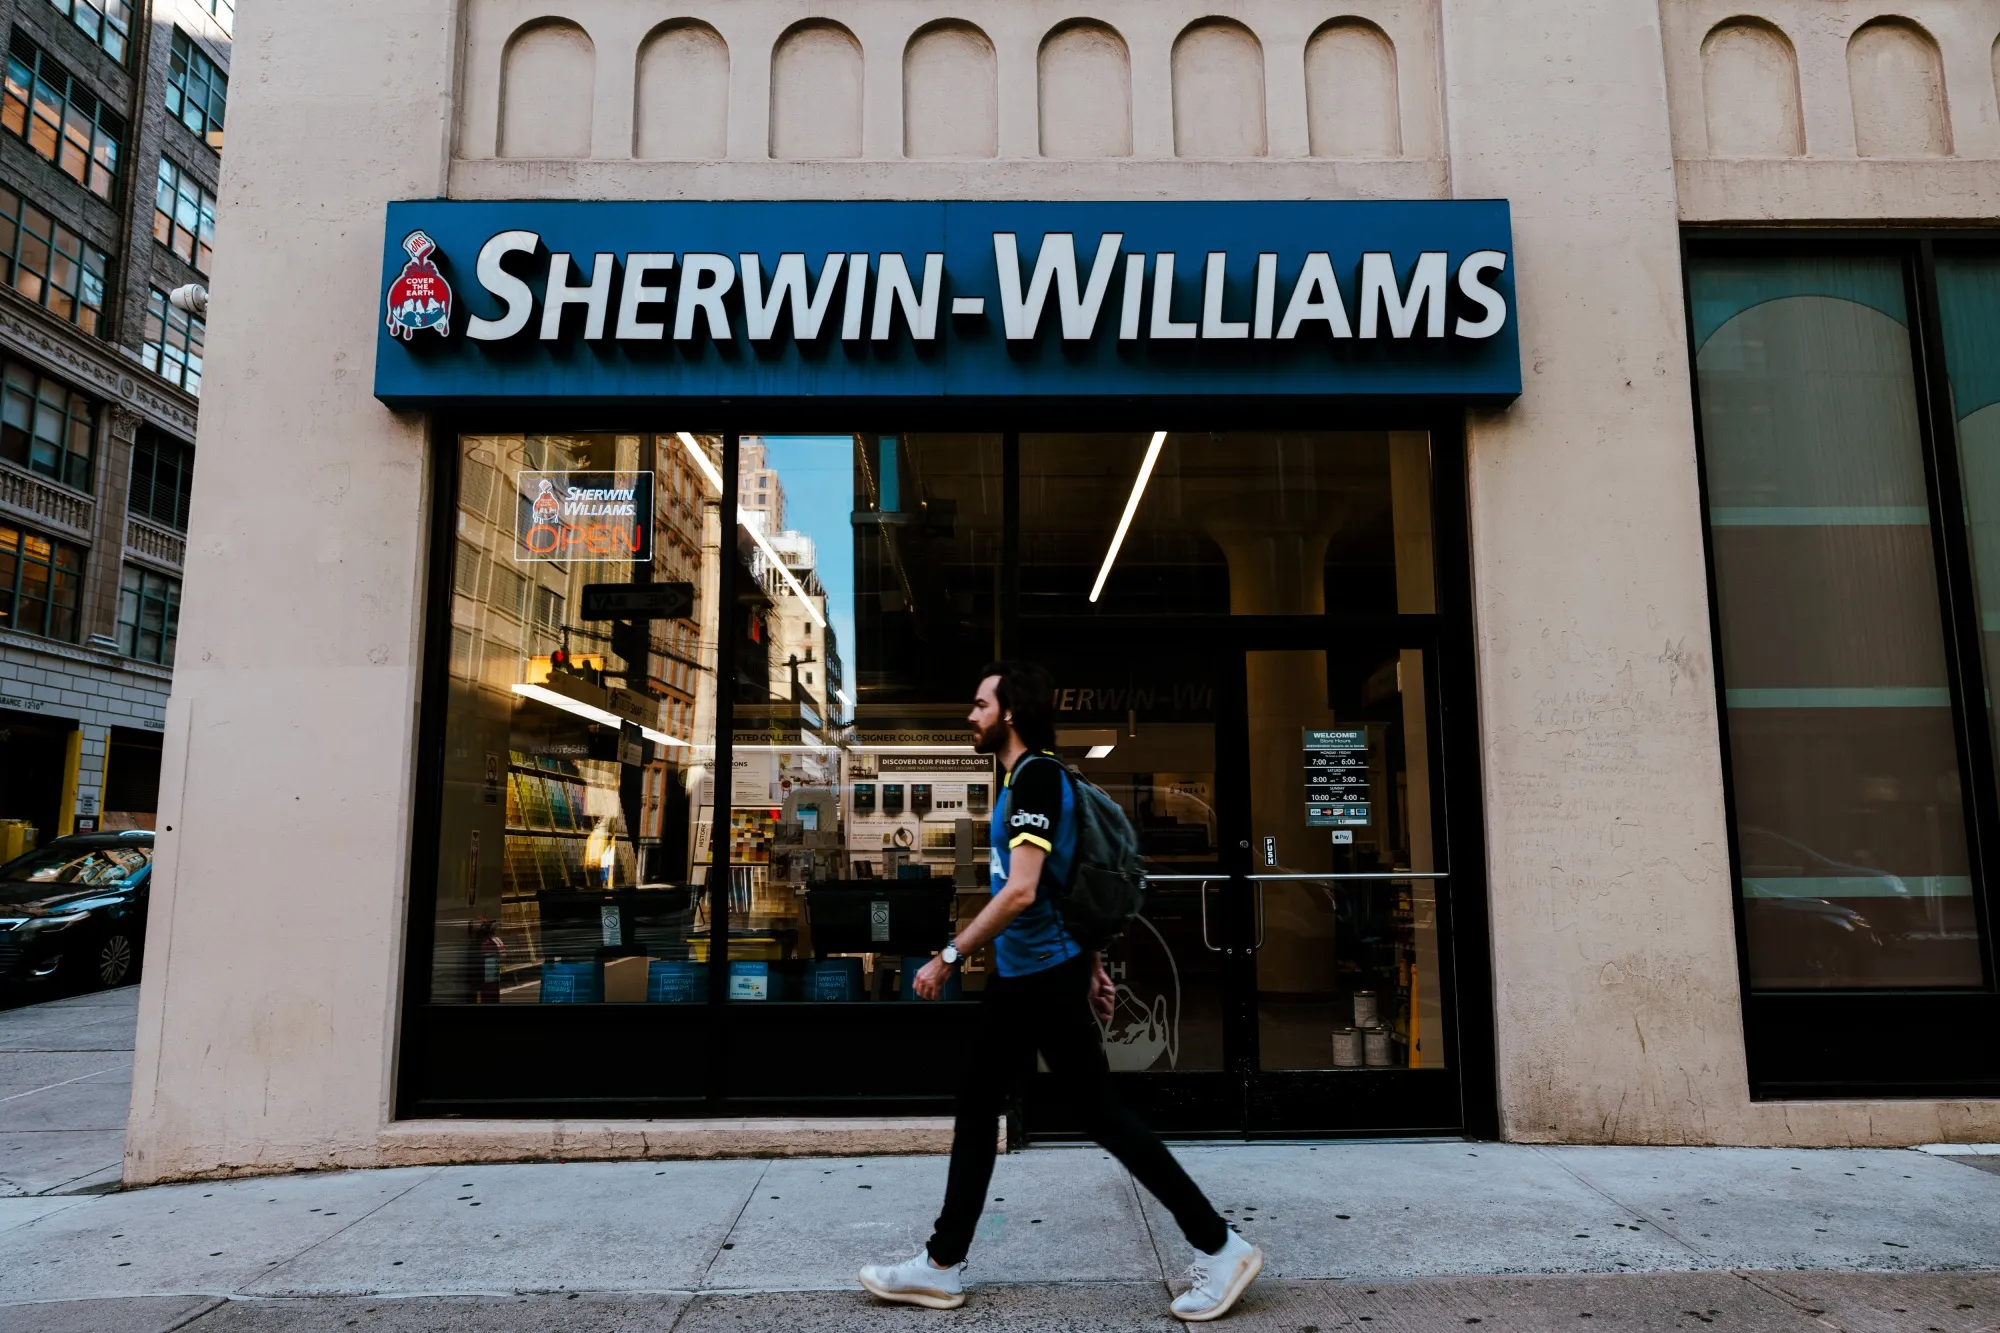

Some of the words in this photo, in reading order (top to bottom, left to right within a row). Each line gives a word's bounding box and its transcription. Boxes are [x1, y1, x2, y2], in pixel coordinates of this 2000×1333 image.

[410, 236, 427, 253] SWP
[466, 229, 1508, 341] SHERWIN-WILLIAMS
[406, 289, 434, 297] EARTH
[565, 486, 635, 501] SHERWIN
[564, 502, 635, 516] WILLIAMS
[525, 524, 642, 554] OPEN
[0, 697, 22, 708] RANCE
[849, 734, 896, 742] DESIGNER
[898, 734, 929, 742] COLOR
[931, 734, 977, 742] COLLECTI
[1266, 838, 1275, 865] PUSH
